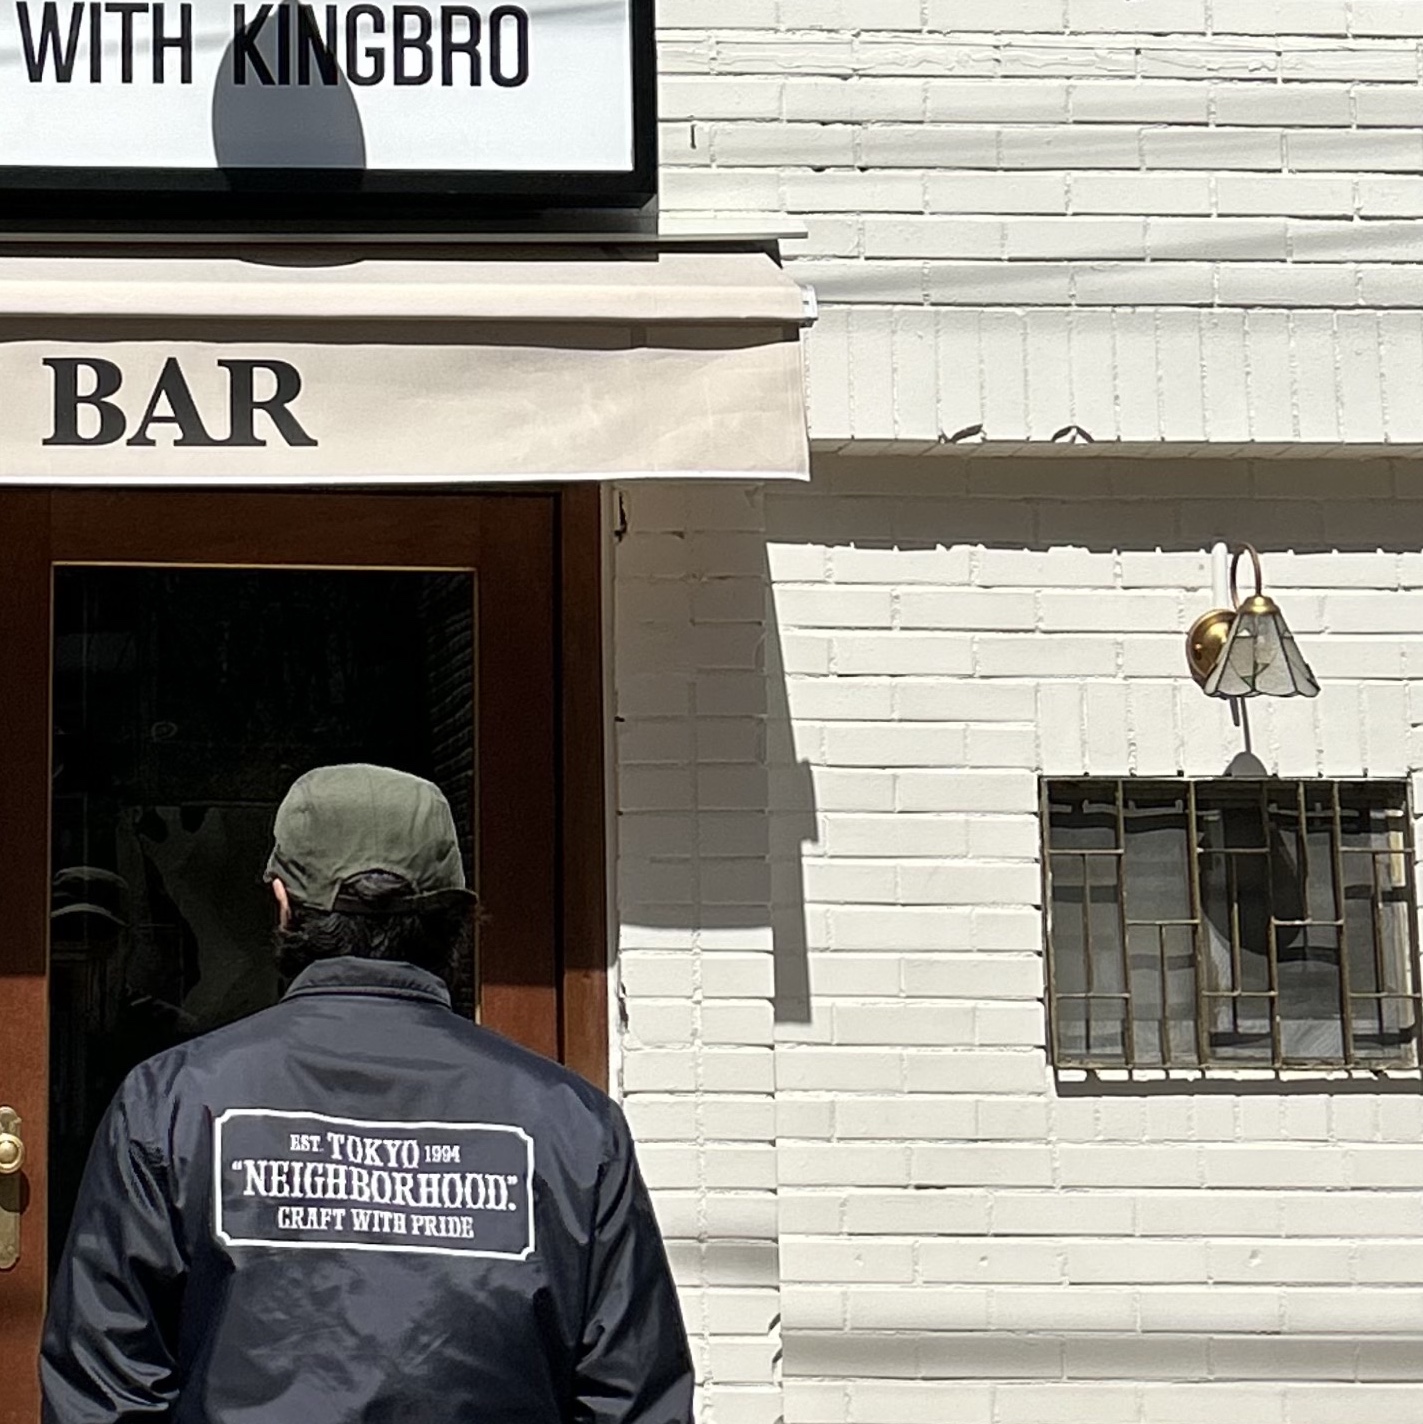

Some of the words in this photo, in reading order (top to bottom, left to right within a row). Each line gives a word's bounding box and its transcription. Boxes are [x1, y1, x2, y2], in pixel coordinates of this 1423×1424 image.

[16, 1, 193, 84] WITH
[233, 3, 530, 88] KINGBRO
[41, 356, 319, 448] BAR
[326, 1131, 420, 1169] TOKYO
[424, 1144, 461, 1164] 1994
[277, 1206, 346, 1230] CRAFT
[350, 1209, 407, 1233] WITH
[410, 1214, 475, 1239] PRIDE
